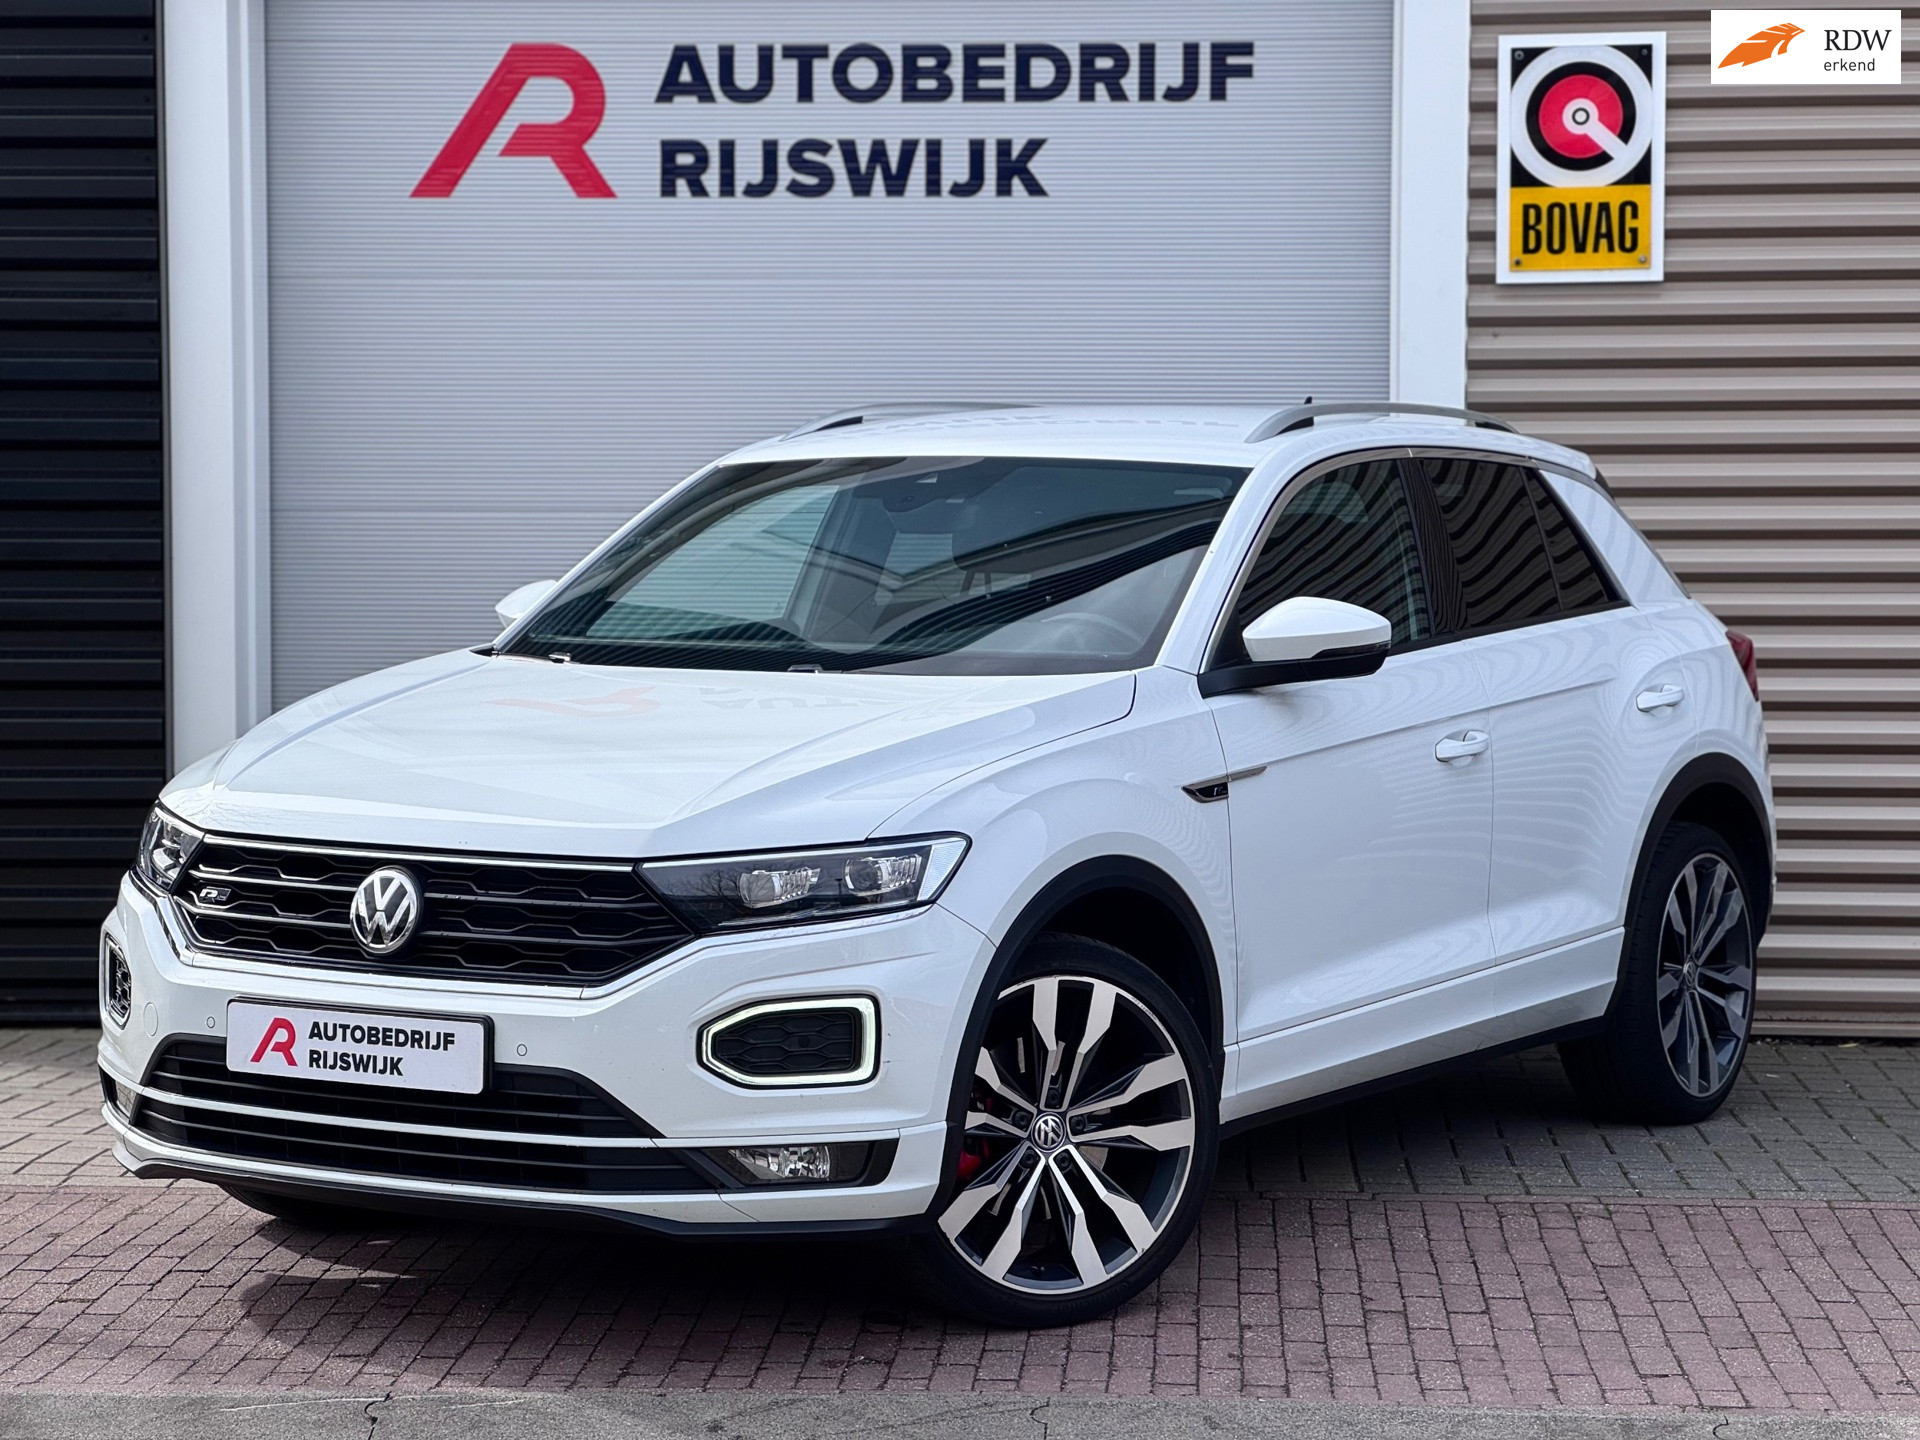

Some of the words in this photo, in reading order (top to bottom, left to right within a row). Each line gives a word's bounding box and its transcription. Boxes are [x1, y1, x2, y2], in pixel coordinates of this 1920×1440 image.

[655, 41, 1255, 104] AUTOBEDRIJF
[659, 138, 1049, 198] RIJSWIJK
[1521, 200, 1639, 255] BOVAG
[308, 1021, 456, 1051] AUTOBEDRIJF
[308, 1050, 404, 1077] RIJSWIJK
